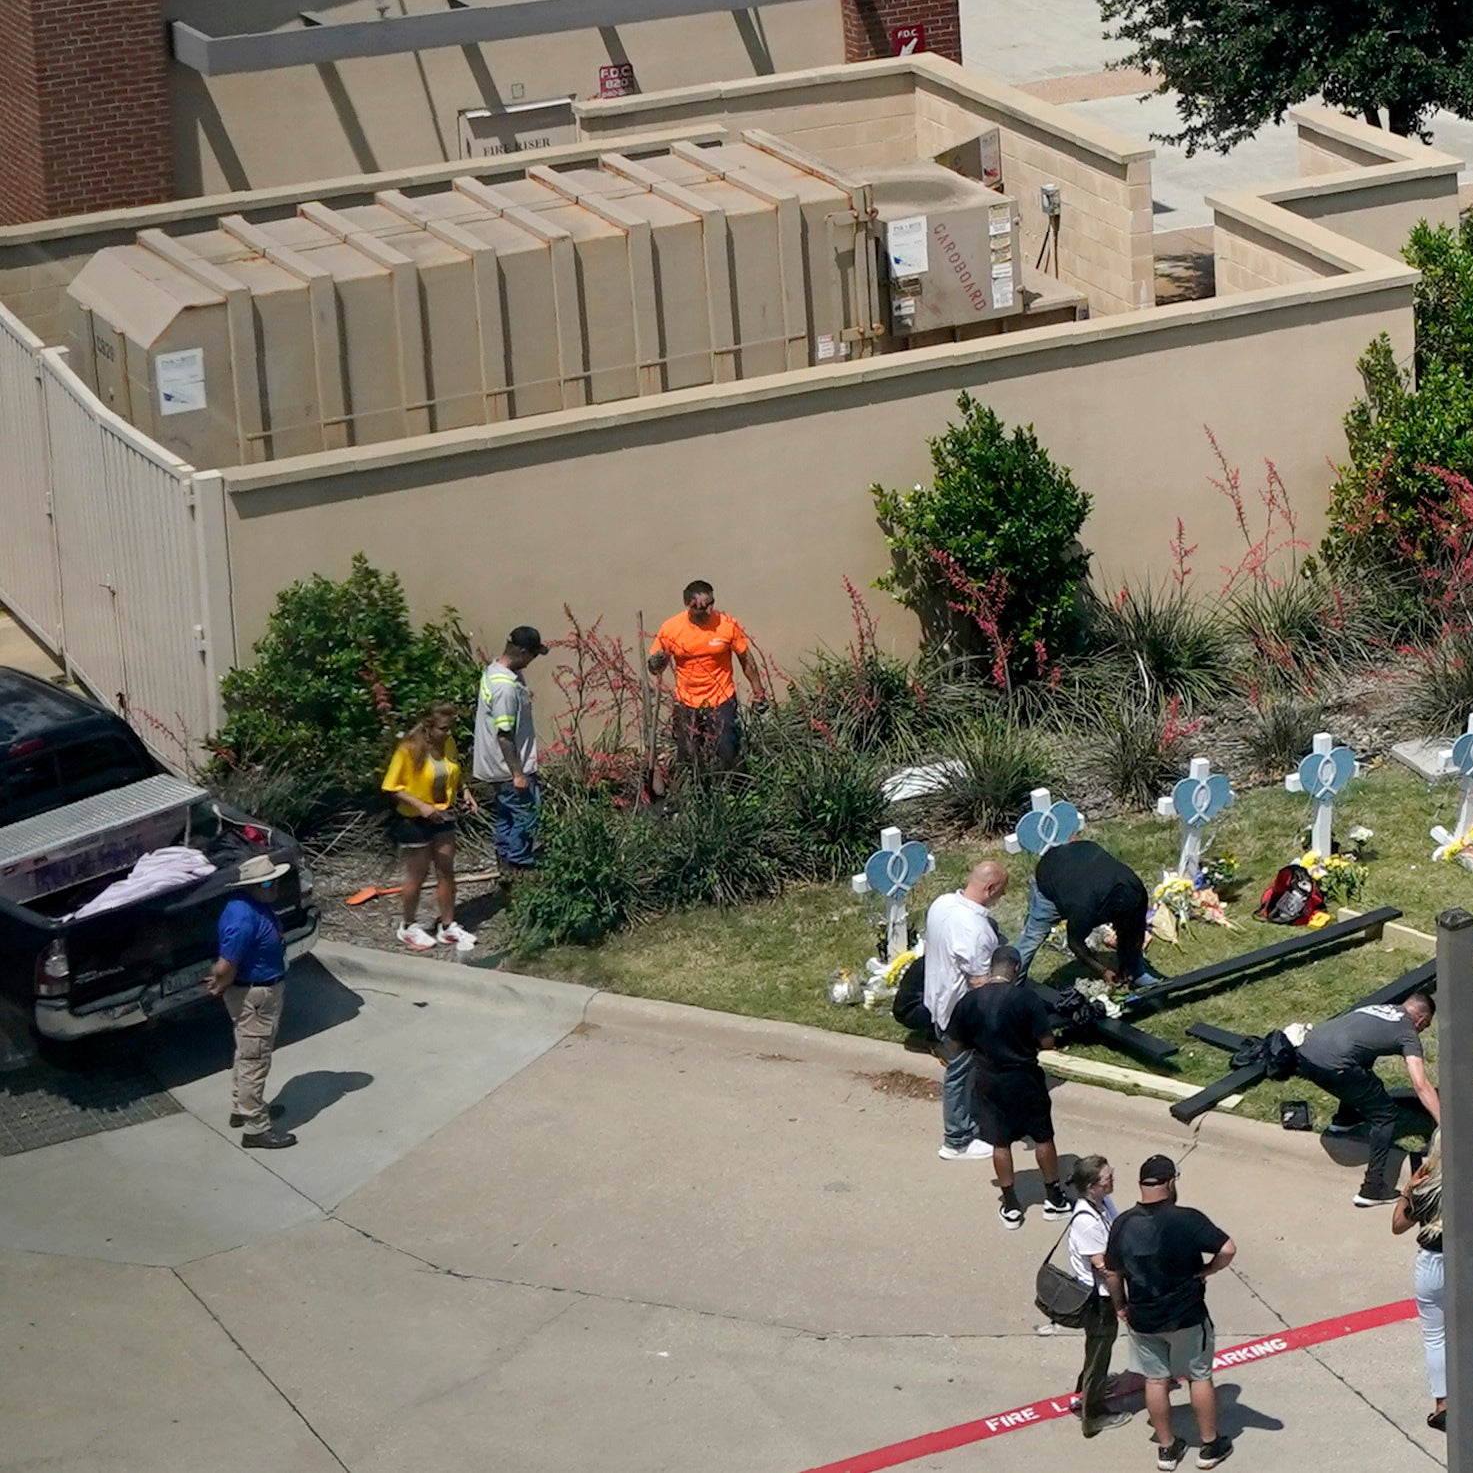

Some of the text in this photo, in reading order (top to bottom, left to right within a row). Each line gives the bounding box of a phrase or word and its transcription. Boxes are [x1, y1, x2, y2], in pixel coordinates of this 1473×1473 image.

[605, 78, 629, 89] 820
[483, 138, 551, 156] FIRE RISER
[984, 1407, 1040, 1433] FIRE
[1211, 1337, 1268, 1369] ARKING
